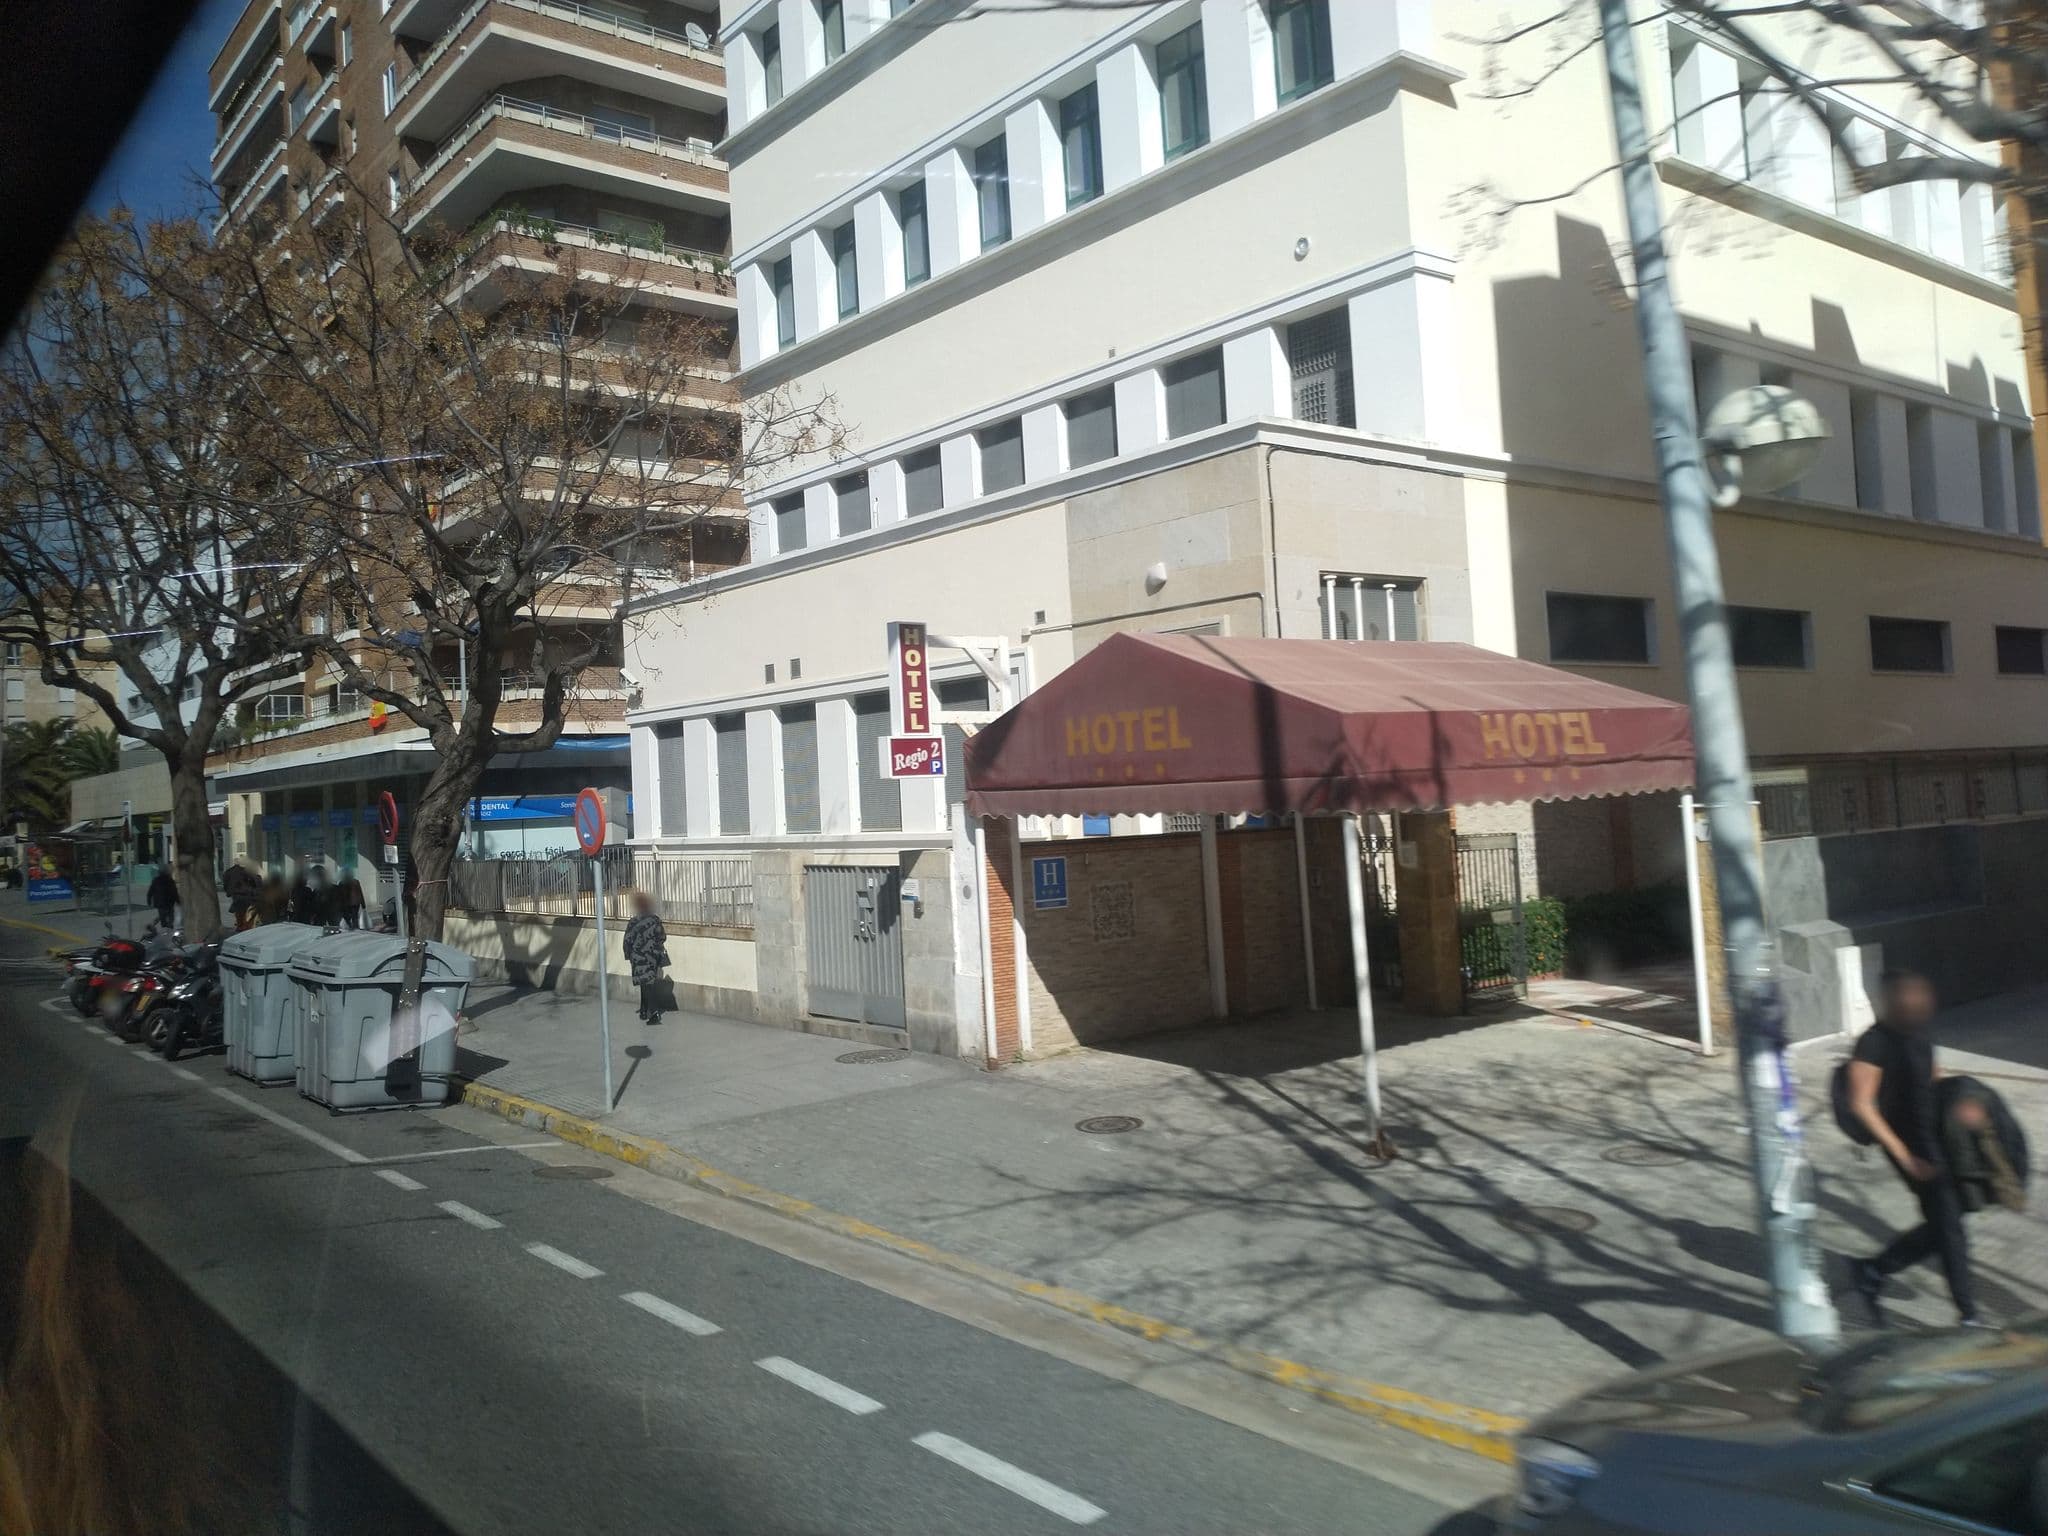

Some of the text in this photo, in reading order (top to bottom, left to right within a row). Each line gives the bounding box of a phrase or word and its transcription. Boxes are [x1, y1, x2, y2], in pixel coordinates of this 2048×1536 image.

[903, 627, 925, 731] HOTEL
[1065, 704, 1193, 758] HOTEL
[1479, 711, 1608, 760] HOTEL
[894, 741, 941, 771] Regio 2
[931, 760, 942, 773] P
[481, 802, 511, 811] DENTAL
[1042, 862, 1059, 887] H
